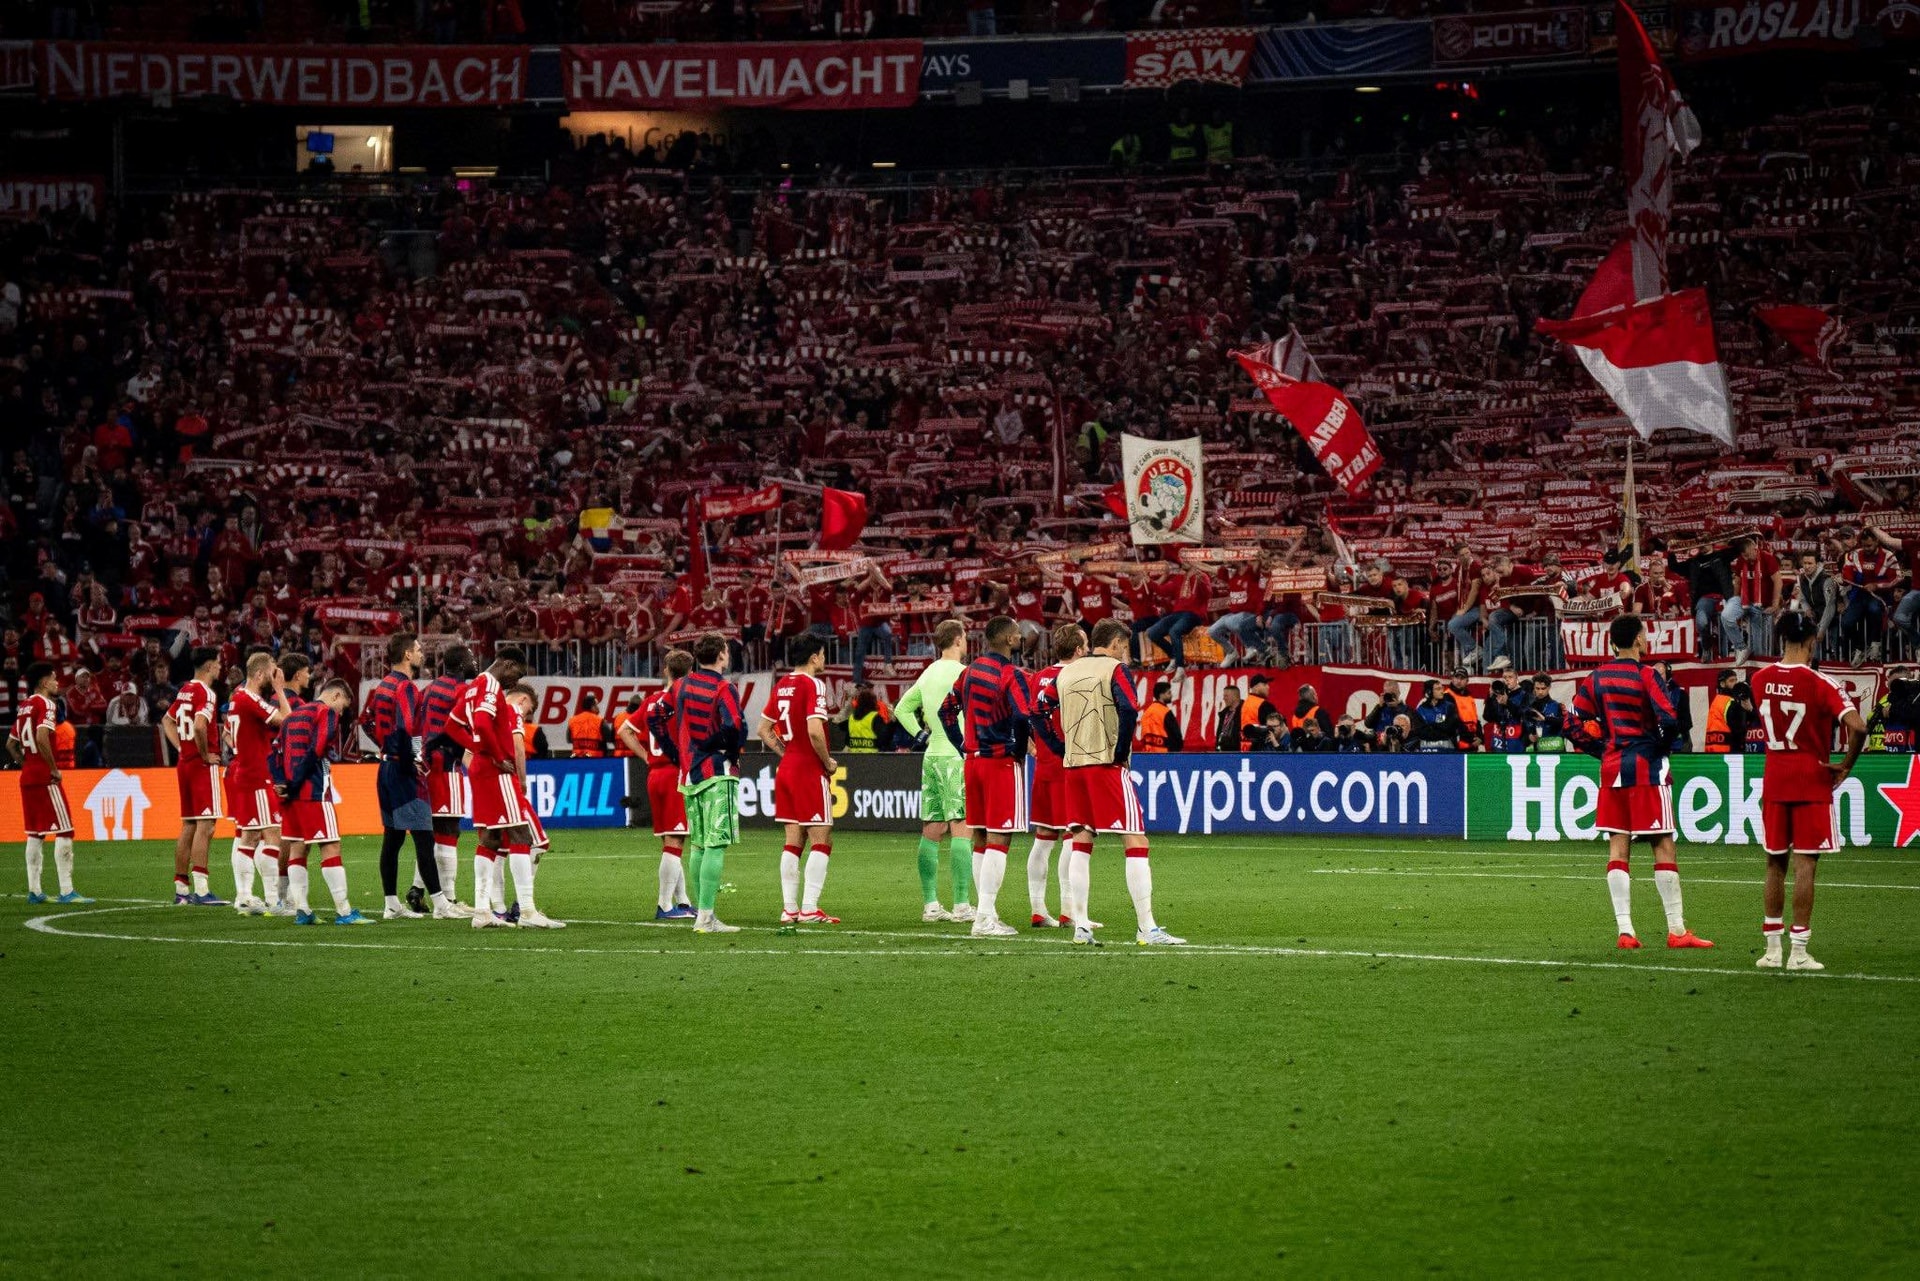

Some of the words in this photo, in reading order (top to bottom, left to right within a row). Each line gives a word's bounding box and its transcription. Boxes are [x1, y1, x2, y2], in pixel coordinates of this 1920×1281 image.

[1708, 0, 1860, 48] RÖSLAU
[1133, 48, 1246, 76] SAW
[1154, 38, 1224, 52] SEKTION
[46, 44, 523, 101] NIEDERWEIDBACH
[570, 54, 917, 99] HAVELMACHT
[1147, 461, 1186, 479] UEFA
[1561, 619, 1695, 657] MÜNHEN
[1765, 682, 1794, 697] OLISE
[777, 699, 794, 742] 3
[1759, 699, 1806, 751] 17
[853, 789, 922, 819] SPORTW
[1506, 754, 1873, 847] Heekn
